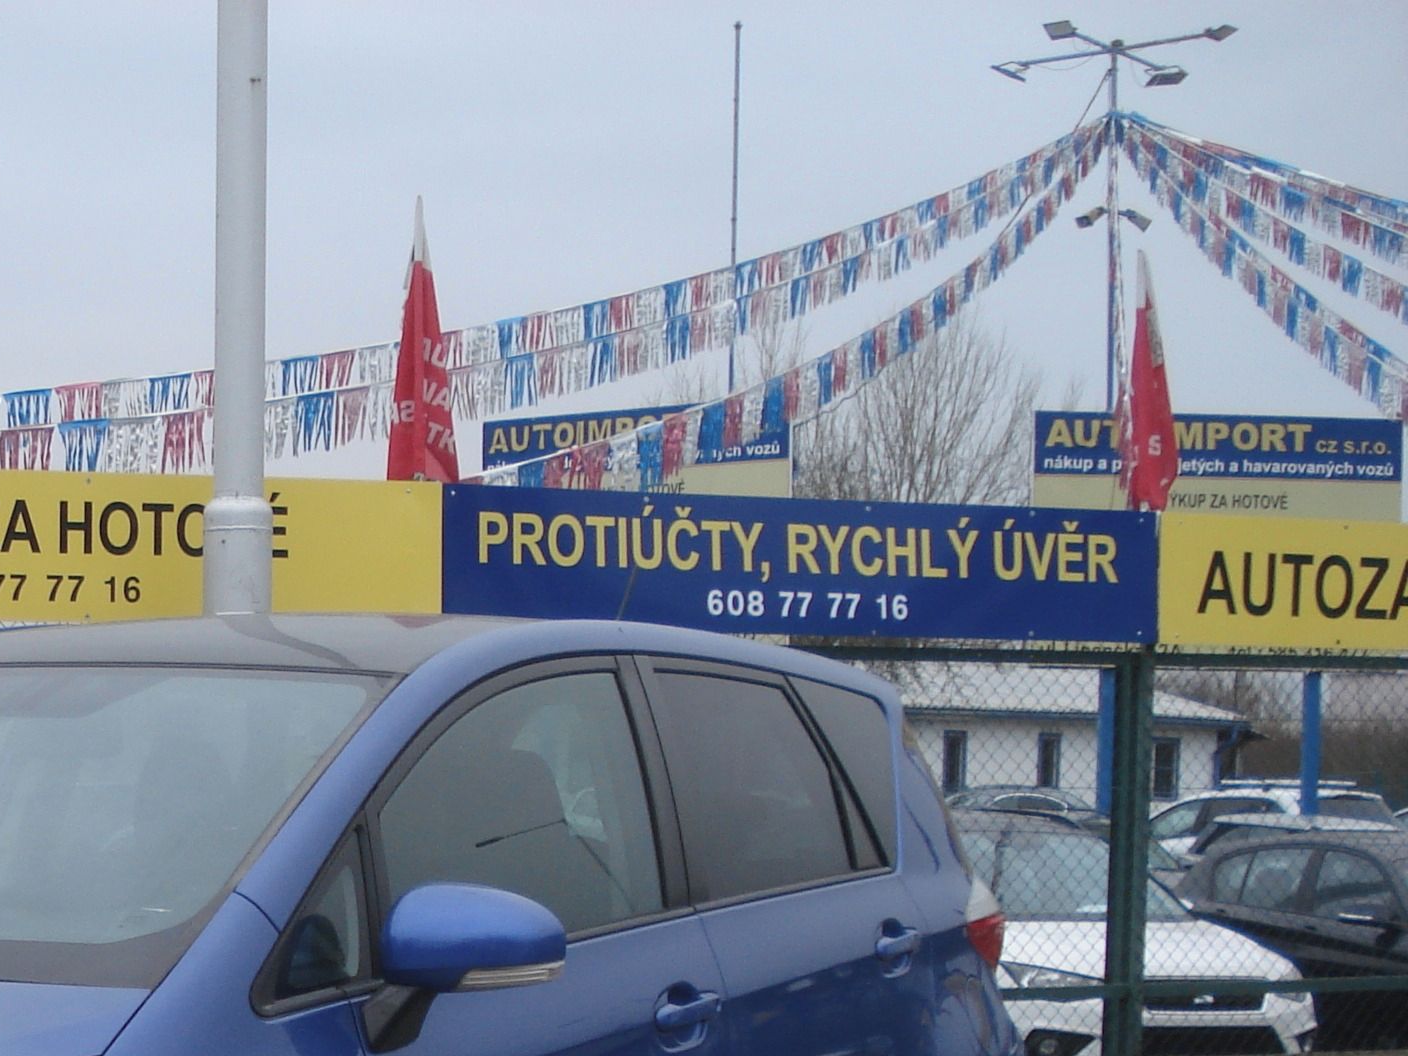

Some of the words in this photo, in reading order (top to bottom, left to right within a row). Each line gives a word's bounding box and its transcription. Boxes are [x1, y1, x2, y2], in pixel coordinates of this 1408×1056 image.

[488, 412, 682, 454] AUTOIMP
[1045, 418, 1312, 453] AUTMPORT
[1315, 439, 1338, 454] cz
[1343, 439, 1392, 455] s.r.o.
[1044, 455, 1093, 473] nákup
[1097, 459, 1108, 470] a
[1177, 457, 1225, 477] jetých
[1228, 460, 1239, 473] a
[1243, 458, 1354, 478] havarovaných
[1169, 491, 1207, 509] ÝKUP
[1210, 493, 1228, 509] ZA
[1232, 493, 1289, 510] HOTOVÉ
[57, 492, 289, 558] HOTOÉ
[477, 505, 770, 583] PROTIÚČTY,
[786, 514, 979, 580] RYCHLÝ
[993, 518, 1119, 584] ÚVĚR
[46, 575, 86, 604] 77
[104, 576, 142, 605] 16
[707, 588, 766, 618] 608
[778, 590, 813, 619] 77
[827, 591, 862, 620] 77
[876, 594, 910, 622] 16
